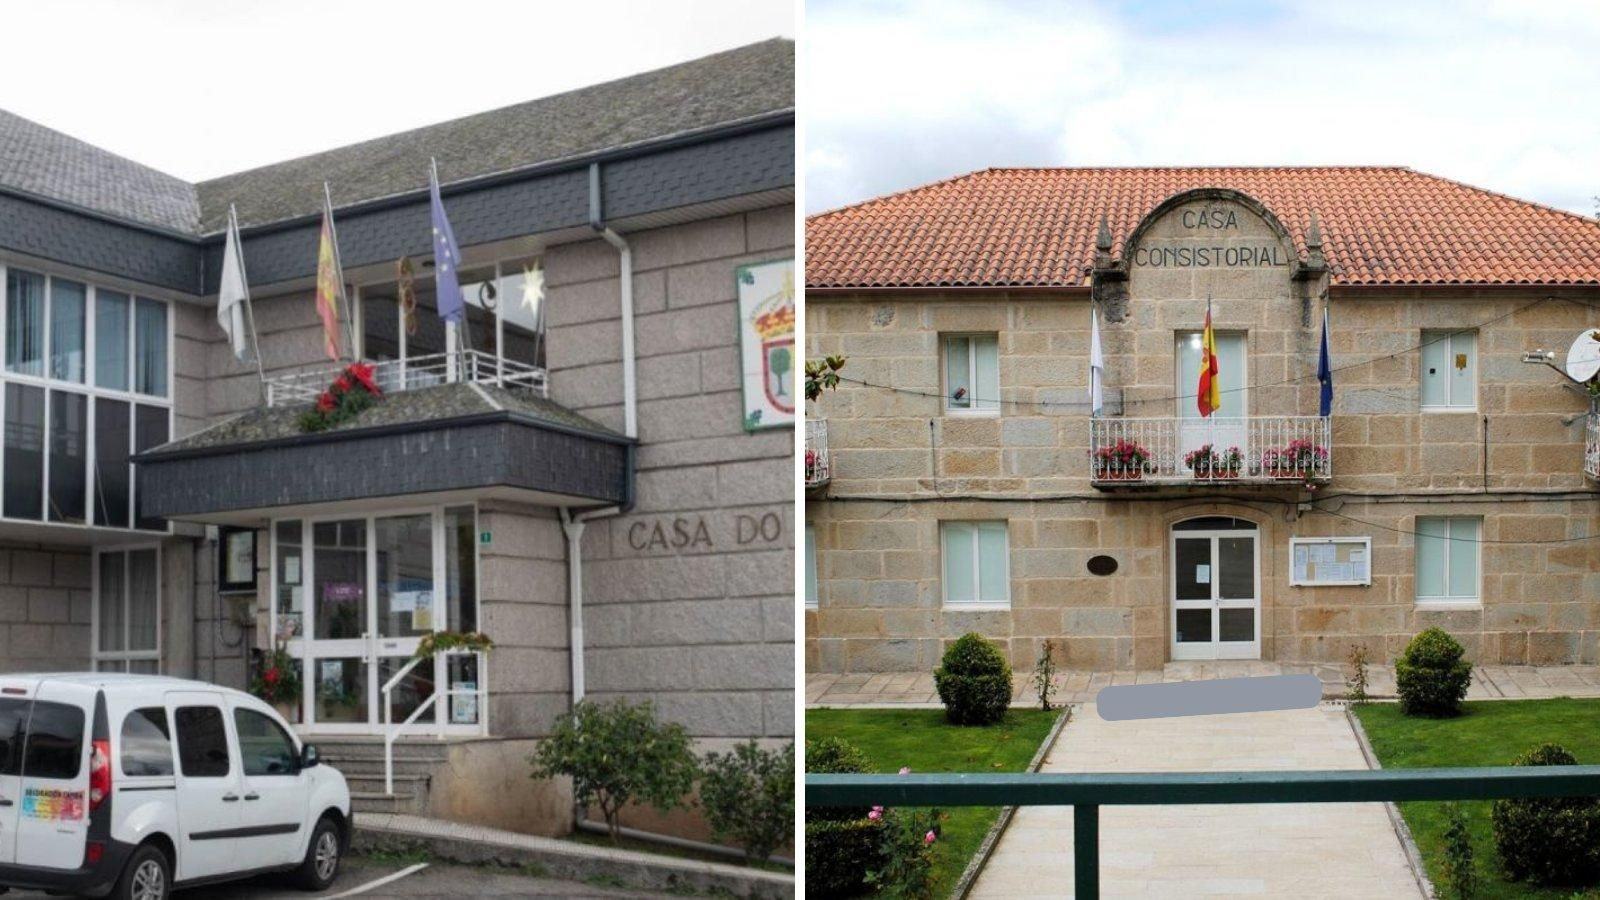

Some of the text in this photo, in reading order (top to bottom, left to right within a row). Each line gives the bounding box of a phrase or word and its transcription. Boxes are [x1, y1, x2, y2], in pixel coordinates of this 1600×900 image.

[1182, 210, 1238, 230] CASA
[1135, 247, 1287, 267] CONSISTORIAL
[628, 512, 781, 550] CASA DO
